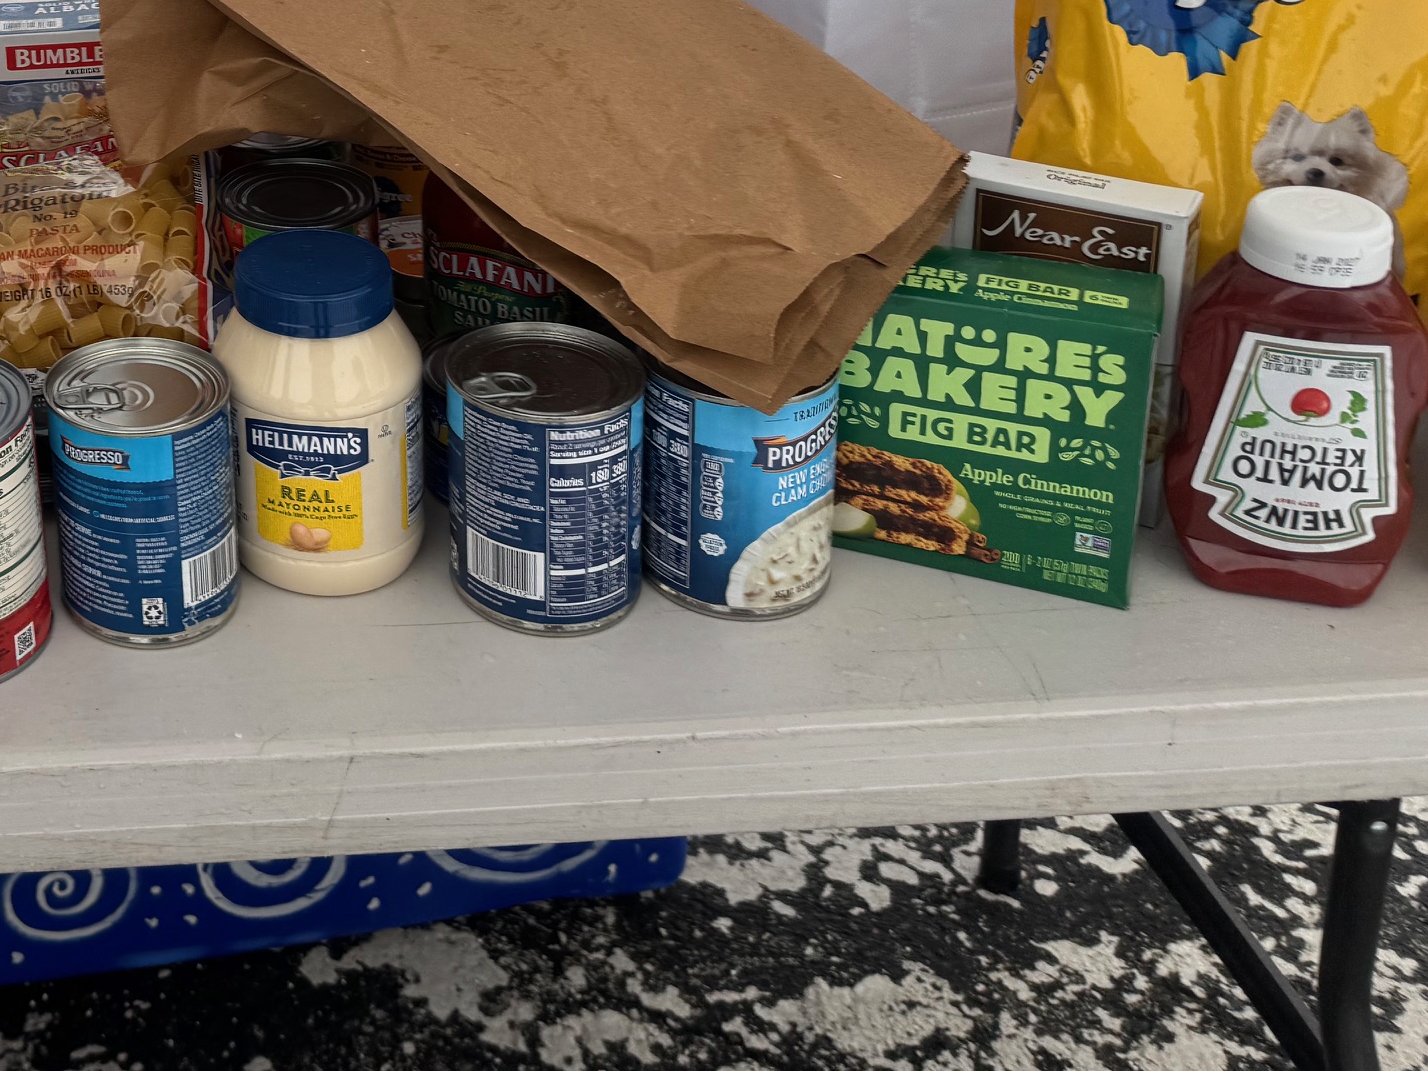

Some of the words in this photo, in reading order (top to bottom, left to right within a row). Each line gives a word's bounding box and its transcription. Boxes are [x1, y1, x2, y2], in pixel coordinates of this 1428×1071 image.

[1, 136, 118, 171] SCLAFAN
[1046, 173, 1106, 190] Original
[32, 213, 57, 222] No.
[63, 210, 79, 219] 19
[30, 224, 81, 237] PASTA
[981, 209, 1081, 248] Near
[1081, 226, 1152, 262] East
[17, 245, 80, 259] MACARONI
[83, 243, 139, 257] PRODUCT
[428, 246, 556, 296] SCLAFANI
[39, 286, 52, 298] 16
[56, 285, 70, 298] OZ
[72, 285, 83, 299] (1
[85, 284, 103, 297] LB)
[106, 284, 134, 297] 453g
[984, 275, 1021, 290] FIG
[1026, 281, 1071, 298] BAR
[430, 280, 492, 315] TOMATO
[496, 302, 552, 323] BASIL
[974, 288, 1011, 302] Apple
[1012, 293, 1079, 311] Cinnamon
[839, 350, 1127, 429] BAKERY
[549, 430, 601, 440] Nutrition
[603, 418, 629, 434] Facts
[901, 411, 954, 439] FIG
[965, 422, 1038, 458] BAR
[64, 440, 123, 466] PROGRESSO
[252, 428, 362, 455] HELLMANN'S
[1241, 436, 1366, 468] KETCHUP
[549, 477, 584, 487] Calories
[778, 469, 808, 490] NEW
[959, 462, 1014, 487] Apple
[1017, 472, 1114, 504] Cinnamon
[1232, 454, 1369, 493] TOMATO
[267, 497, 352, 513] MAYONNAISE
[281, 485, 336, 504] REAL
[772, 484, 807, 507] CLAM
[994, 490, 1022, 501] WHOLE
[1024, 495, 1054, 506] GRAINS
[1063, 502, 1085, 511] REAL
[1086, 506, 1112, 516] FRUIT
[1243, 497, 1346, 531] HEINZ
